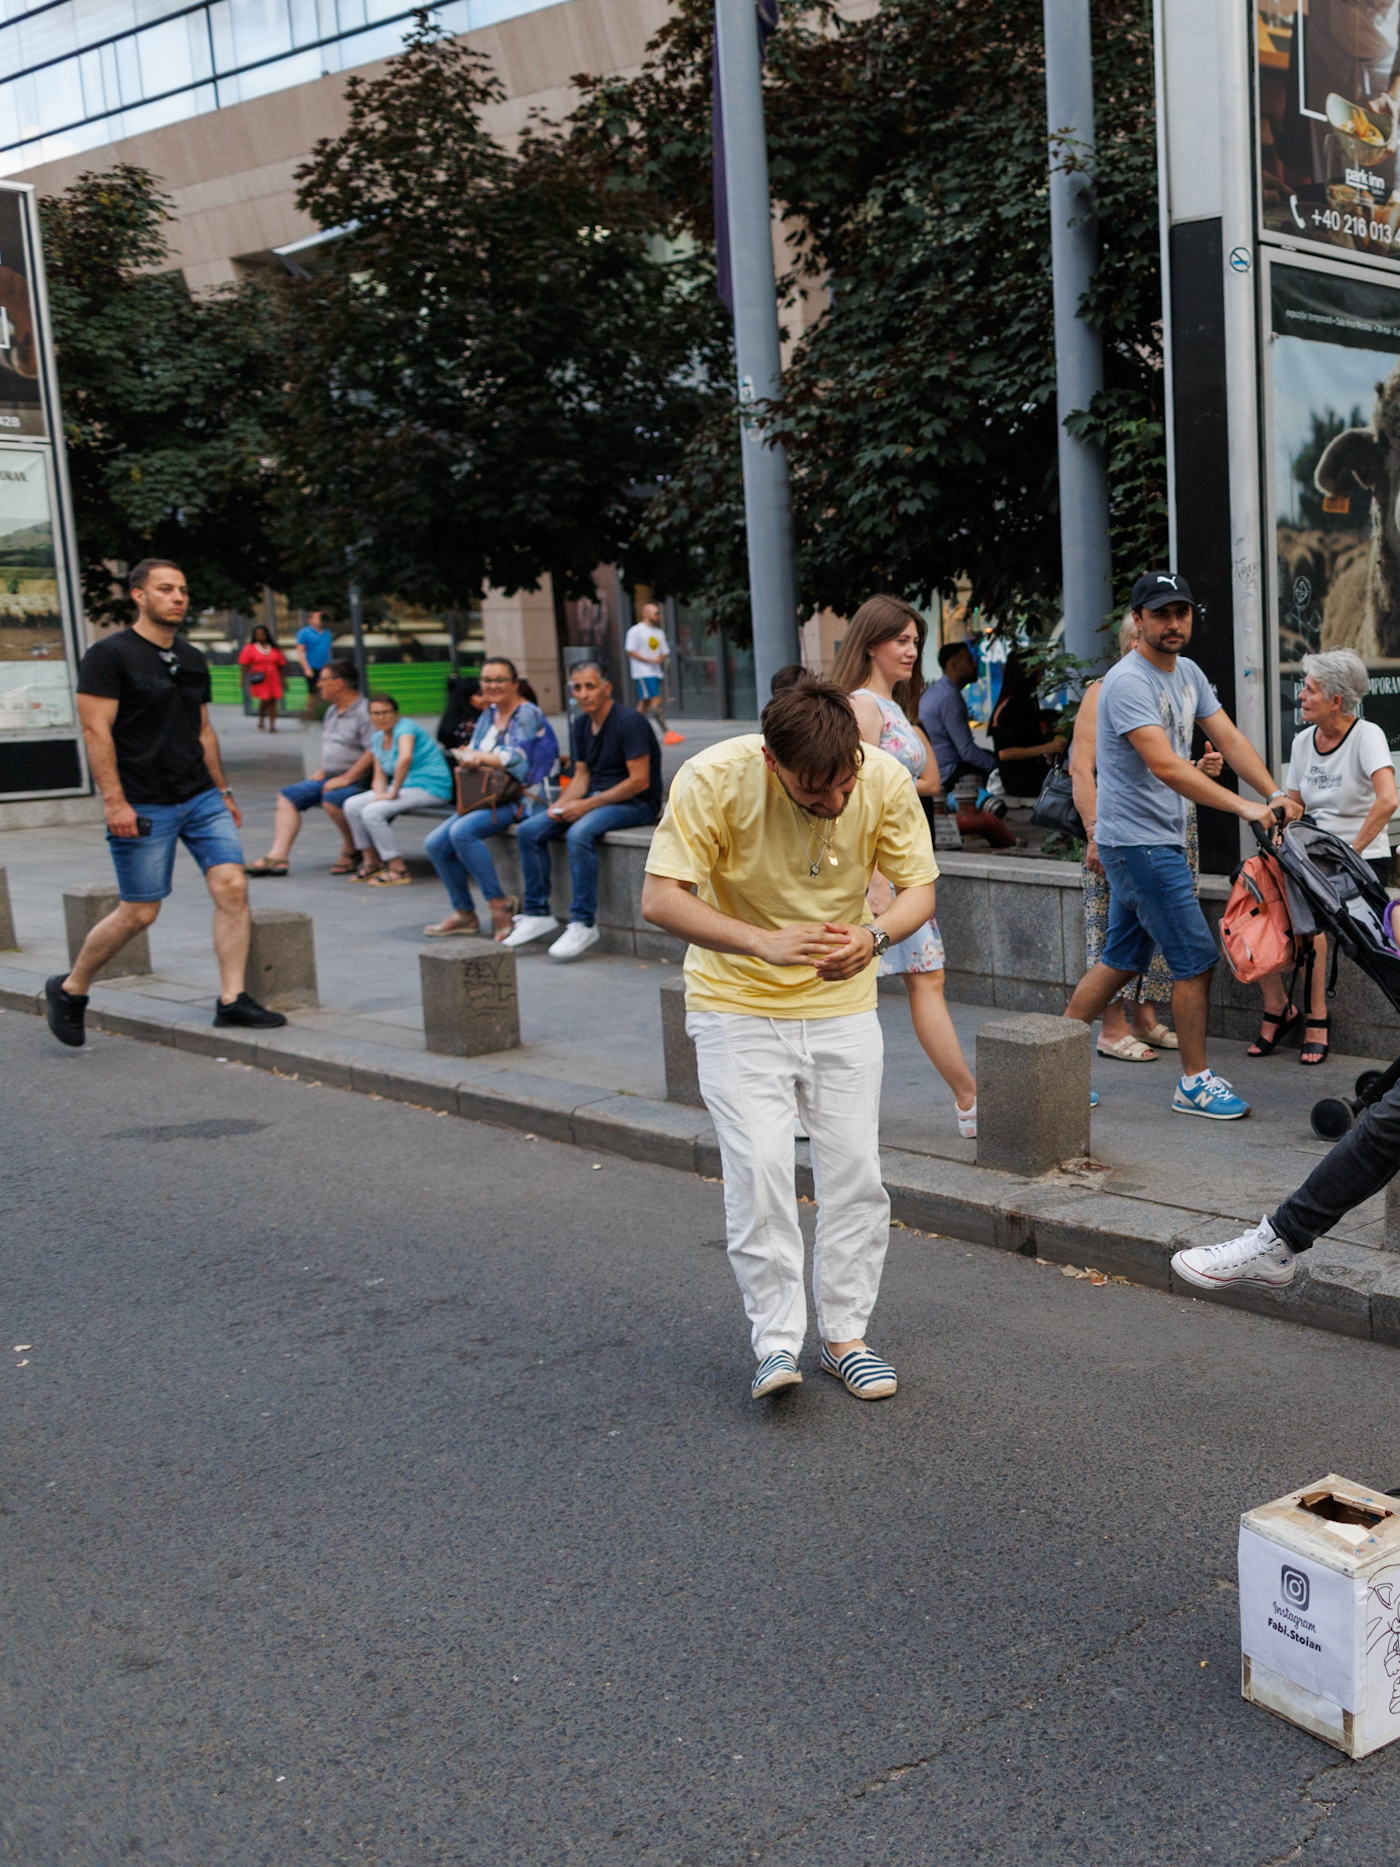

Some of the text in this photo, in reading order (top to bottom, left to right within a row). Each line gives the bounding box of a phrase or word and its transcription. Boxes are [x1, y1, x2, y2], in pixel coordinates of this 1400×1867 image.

[1311, 209, 1341, 231] +40
[1343, 215, 1367, 238] 216
[1369, 221, 1392, 243] 013
[1272, 1601, 1317, 1633] Instagram
[1268, 1617, 1322, 1652] Fabi.Stoian
